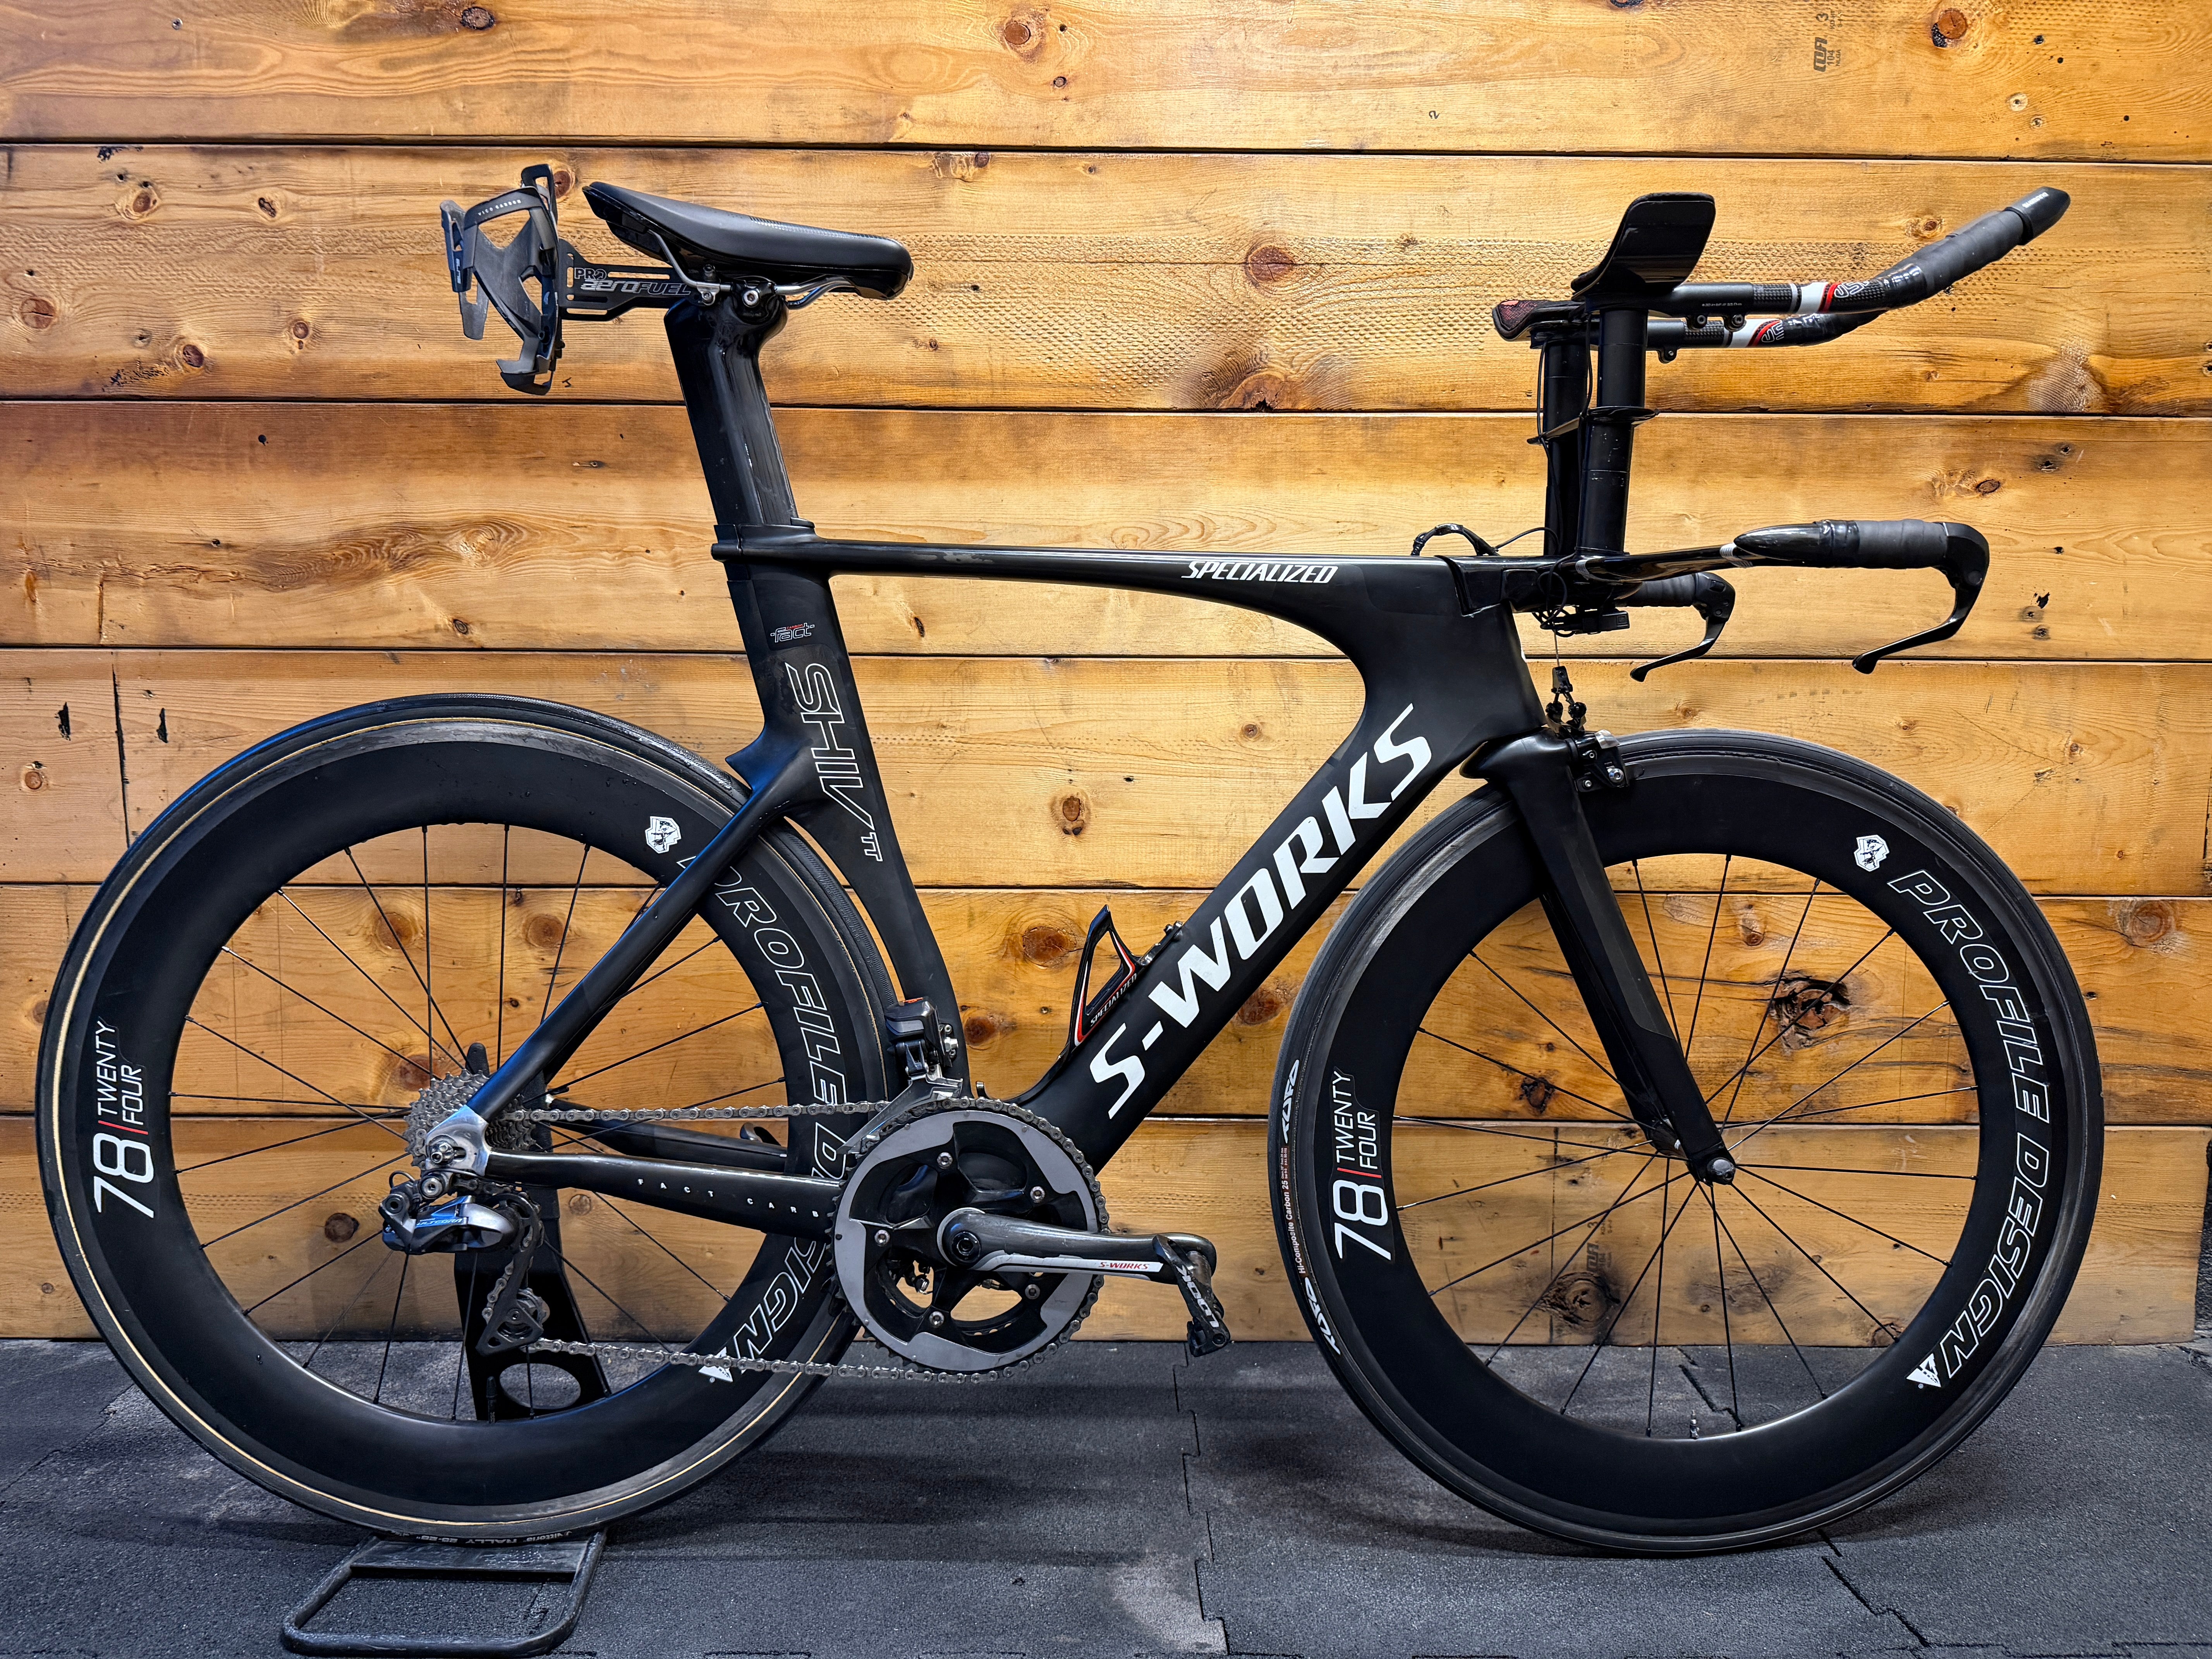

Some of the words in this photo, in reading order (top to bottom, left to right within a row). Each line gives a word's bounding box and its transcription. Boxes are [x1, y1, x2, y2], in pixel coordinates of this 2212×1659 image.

[574, 268, 607, 280] PRO
[1181, 560, 1339, 584] SPECIALIZED
[785, 662, 875, 831] SHIV
[860, 831, 883, 862] TT
[1089, 702, 1432, 1120] S-WORKS
[1090, 972, 1137, 1027] SPECIALIZED
[1887, 869, 2049, 1124] PROFILE
[95, 1020, 118, 1116] TWENTY
[121, 1065, 144, 1126] FOUR
[1332, 1070, 1355, 1163] TWENTY
[1357, 1111, 1378, 1170] FOUR
[93, 1133, 154, 1218] 78
[638, 1178, 715, 1198] FACT
[1281, 1180, 1289, 1190] 25
[1283, 1192, 1293, 1220] Carbon
[1288, 1222, 1306, 1274] Hi-Composite
[1332, 1179, 1391, 1261] 78
[1098, 1261, 1150, 1271] S-WORKS
[1940, 1132, 2050, 1379] DESIGN
[1174, 1264, 1219, 1328] LOOK
